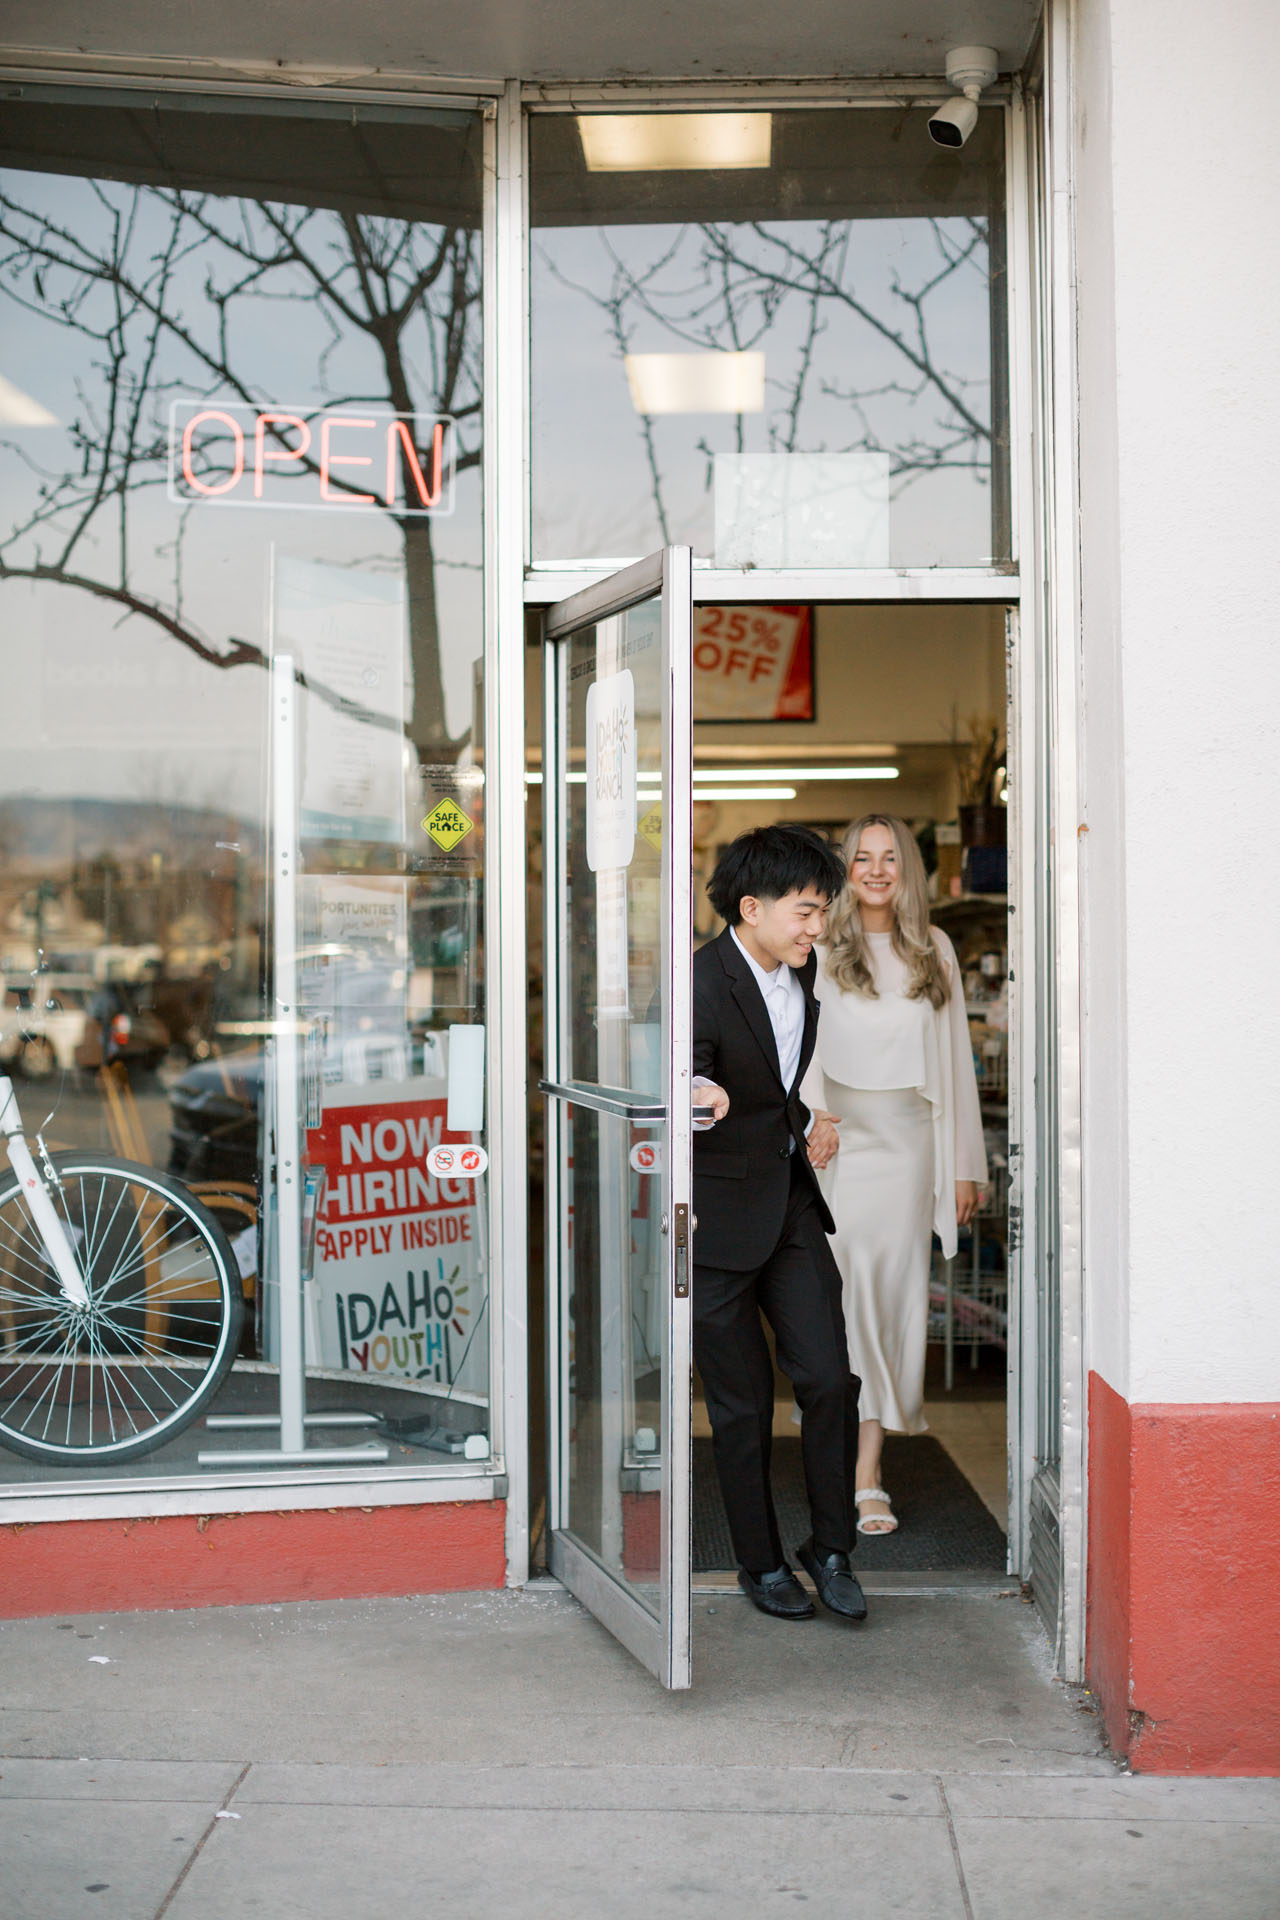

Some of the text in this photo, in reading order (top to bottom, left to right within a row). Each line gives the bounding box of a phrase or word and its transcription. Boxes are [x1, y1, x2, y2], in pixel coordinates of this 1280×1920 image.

[182, 411, 444, 507] OPEN
[699, 607, 781, 653] 25%
[693, 642, 777, 683] OFF
[434, 812, 459, 822] SAFE
[340, 1116, 443, 1166] NOW
[323, 1168, 469, 1217] HIRING
[322, 1214, 472, 1262] APPLY INSIDE
[336, 1270, 453, 1361] IDAHO
[351, 1322, 443, 1371] YOUTH
